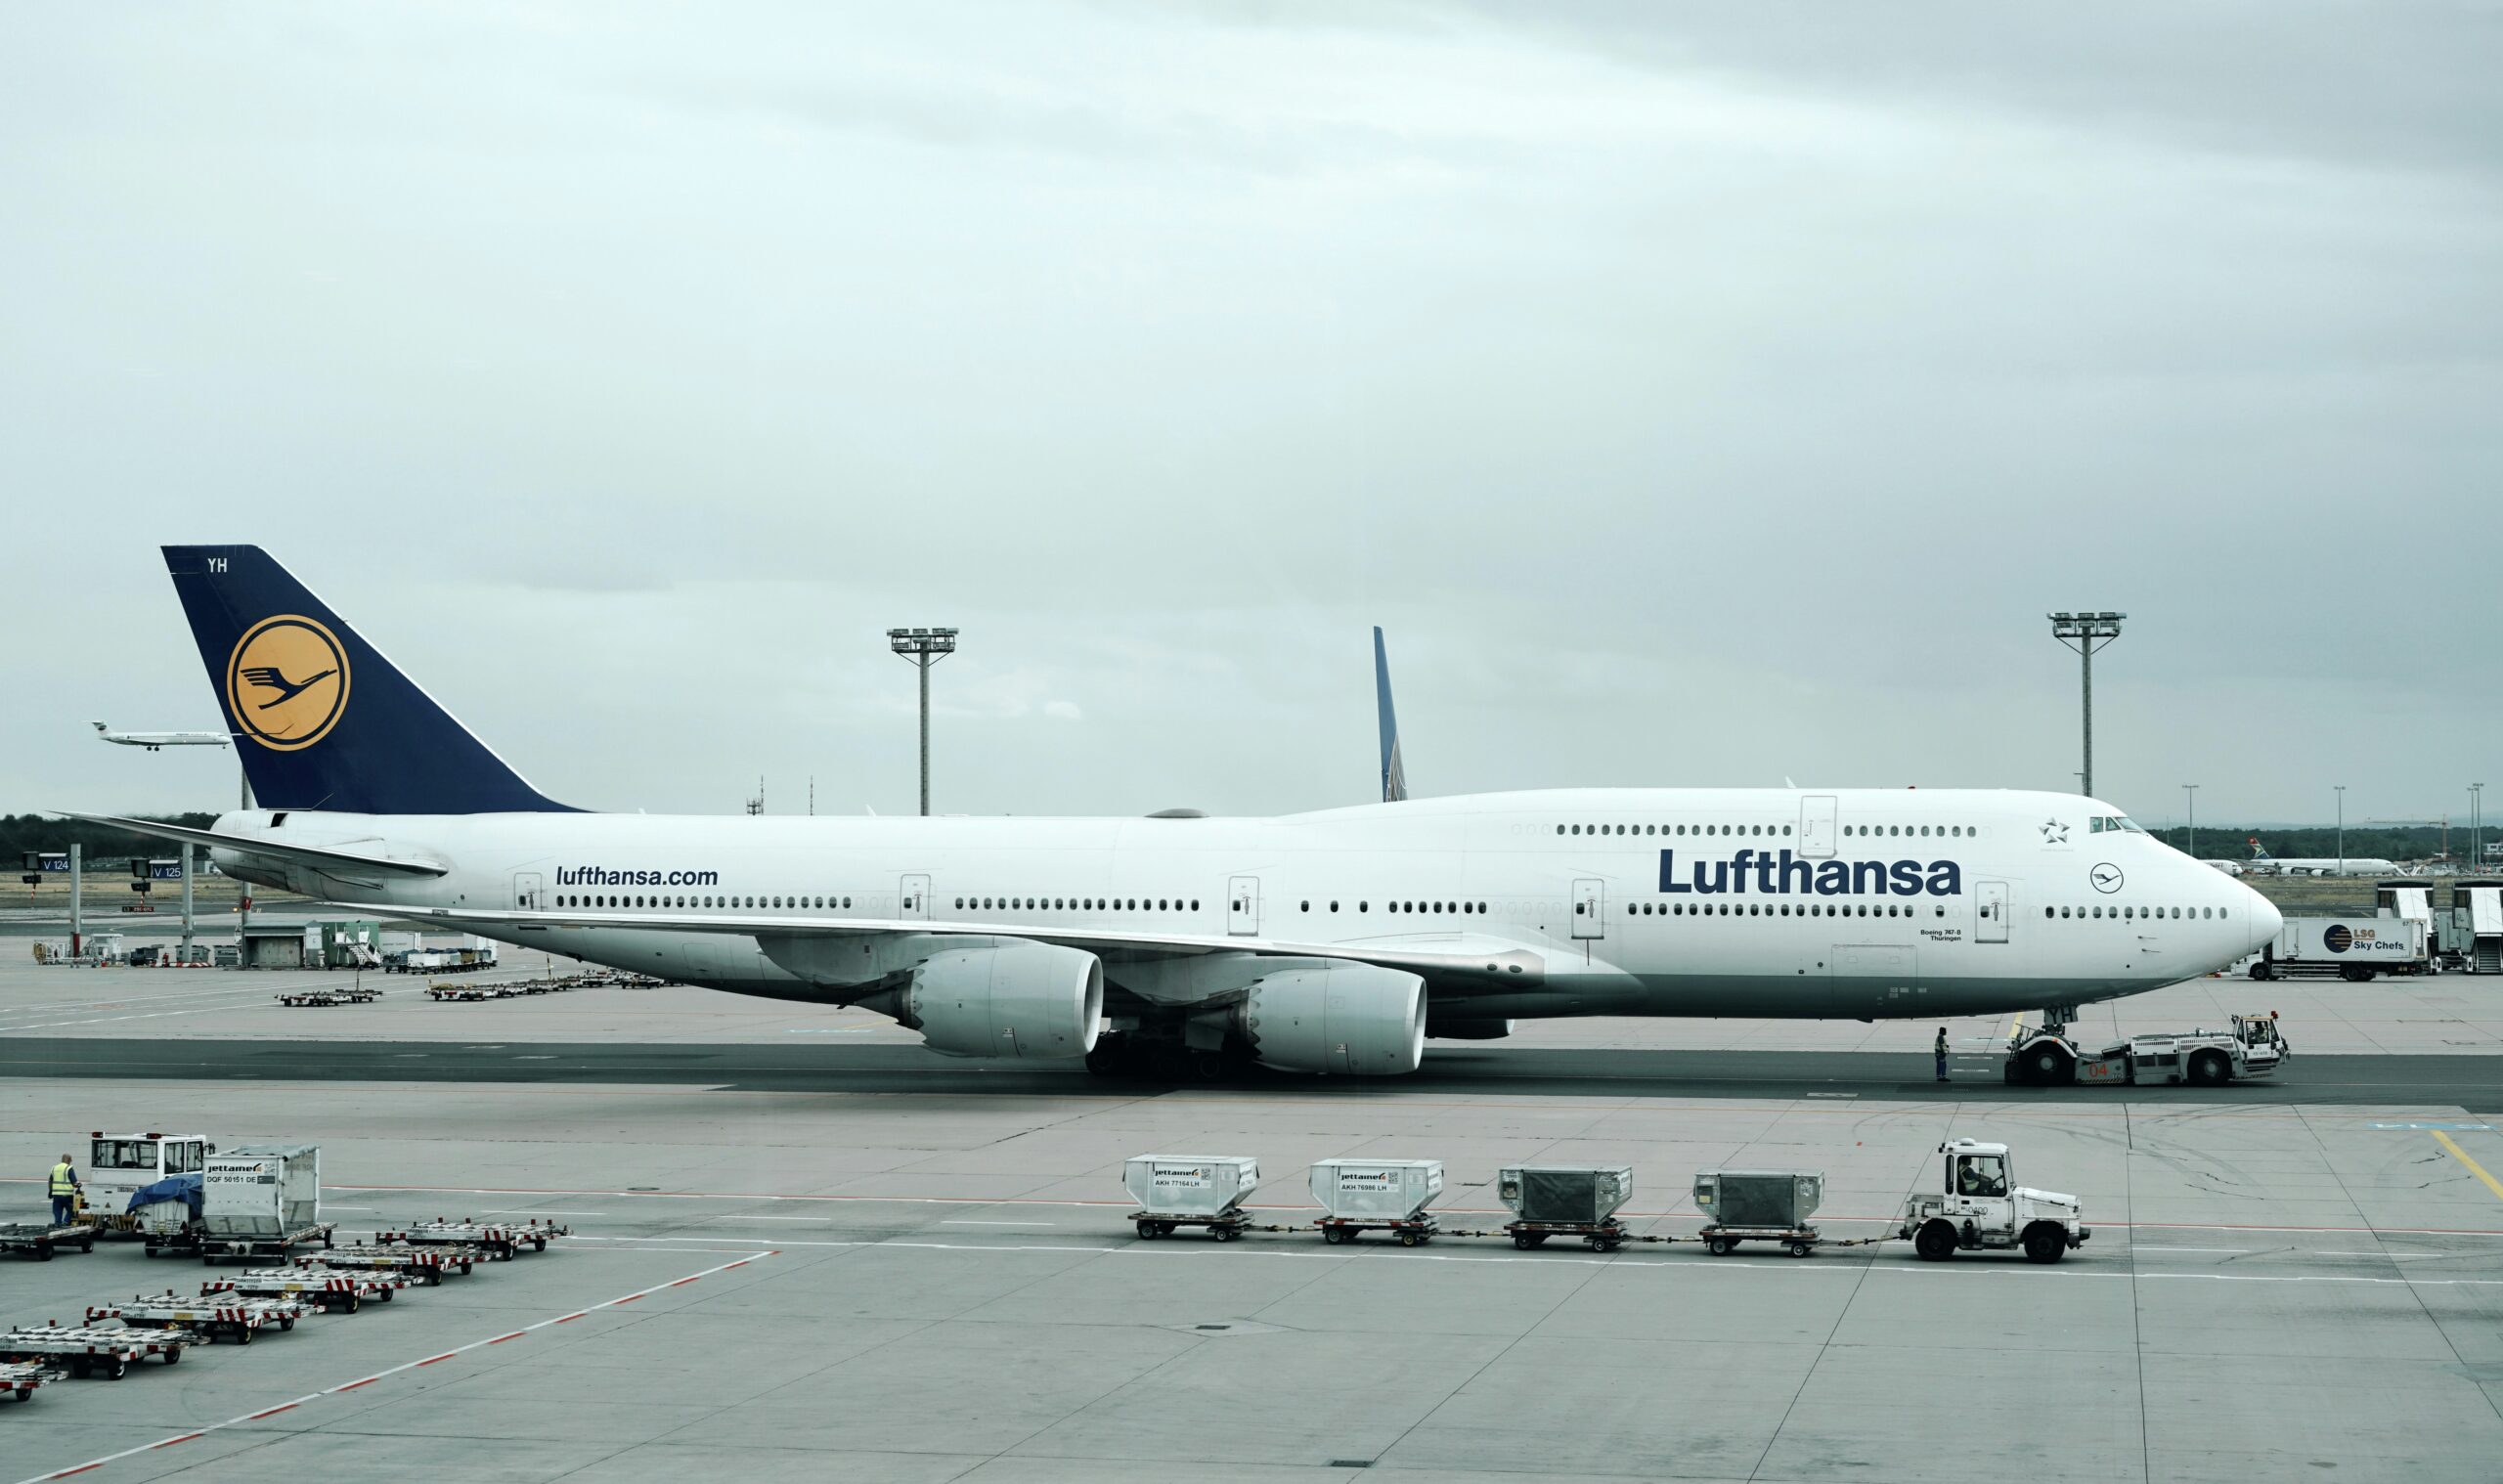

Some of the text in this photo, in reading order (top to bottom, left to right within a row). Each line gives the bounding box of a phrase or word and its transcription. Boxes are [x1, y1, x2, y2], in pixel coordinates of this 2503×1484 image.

[207, 557, 228, 573] YH
[43, 860, 69, 870] V 124
[1659, 849, 1962, 895] Lufthansa
[154, 867, 181, 878] V 125
[556, 866, 719, 886] lufthansa.com
[2353, 929, 2376, 938] LSG
[2353, 940, 2404, 951] Sky Chefs
[2048, 1007, 2074, 1025] YH
[2088, 1063, 2108, 1077] 04
